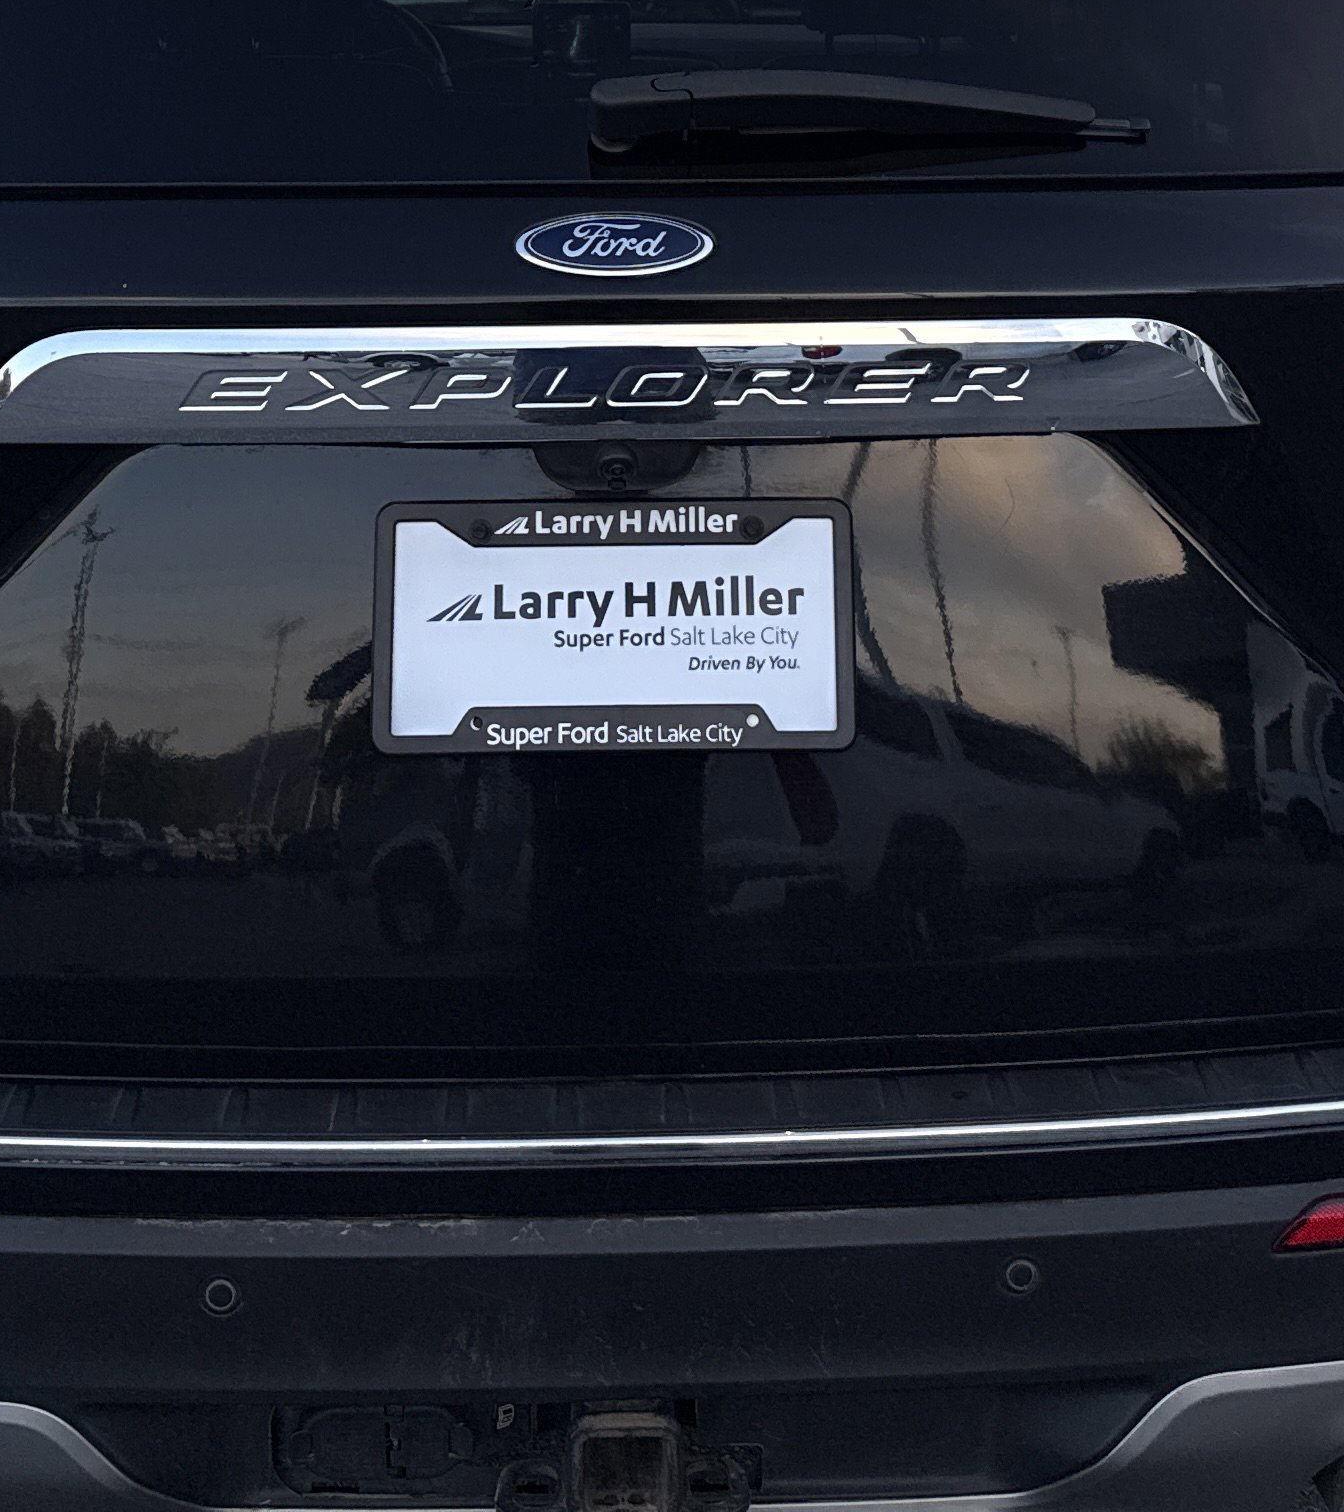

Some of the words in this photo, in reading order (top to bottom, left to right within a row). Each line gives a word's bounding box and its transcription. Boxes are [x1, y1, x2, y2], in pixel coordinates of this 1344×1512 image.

[563, 223, 667, 258] Ford
[179, 362, 1031, 412] EXPLORER
[535, 510, 614, 539] Larry
[620, 511, 642, 533] H
[649, 506, 738, 532] Miller
[494, 584, 614, 627] Larry
[625, 582, 656, 618] H
[668, 575, 804, 617] Miller
[553, 629, 614, 652] Super
[619, 627, 665, 647] Ford
[670, 625, 705, 646] Salt
[711, 624, 756, 646] Lake
[760, 624, 799, 649] City
[688, 655, 741, 671] Driven
[745, 655, 765, 674] By
[486, 723, 553, 750] Super
[558, 722, 609, 744] Ford
[616, 725, 653, 744] Salt
[657, 724, 701, 743] Lake
[706, 722, 743, 747] City
